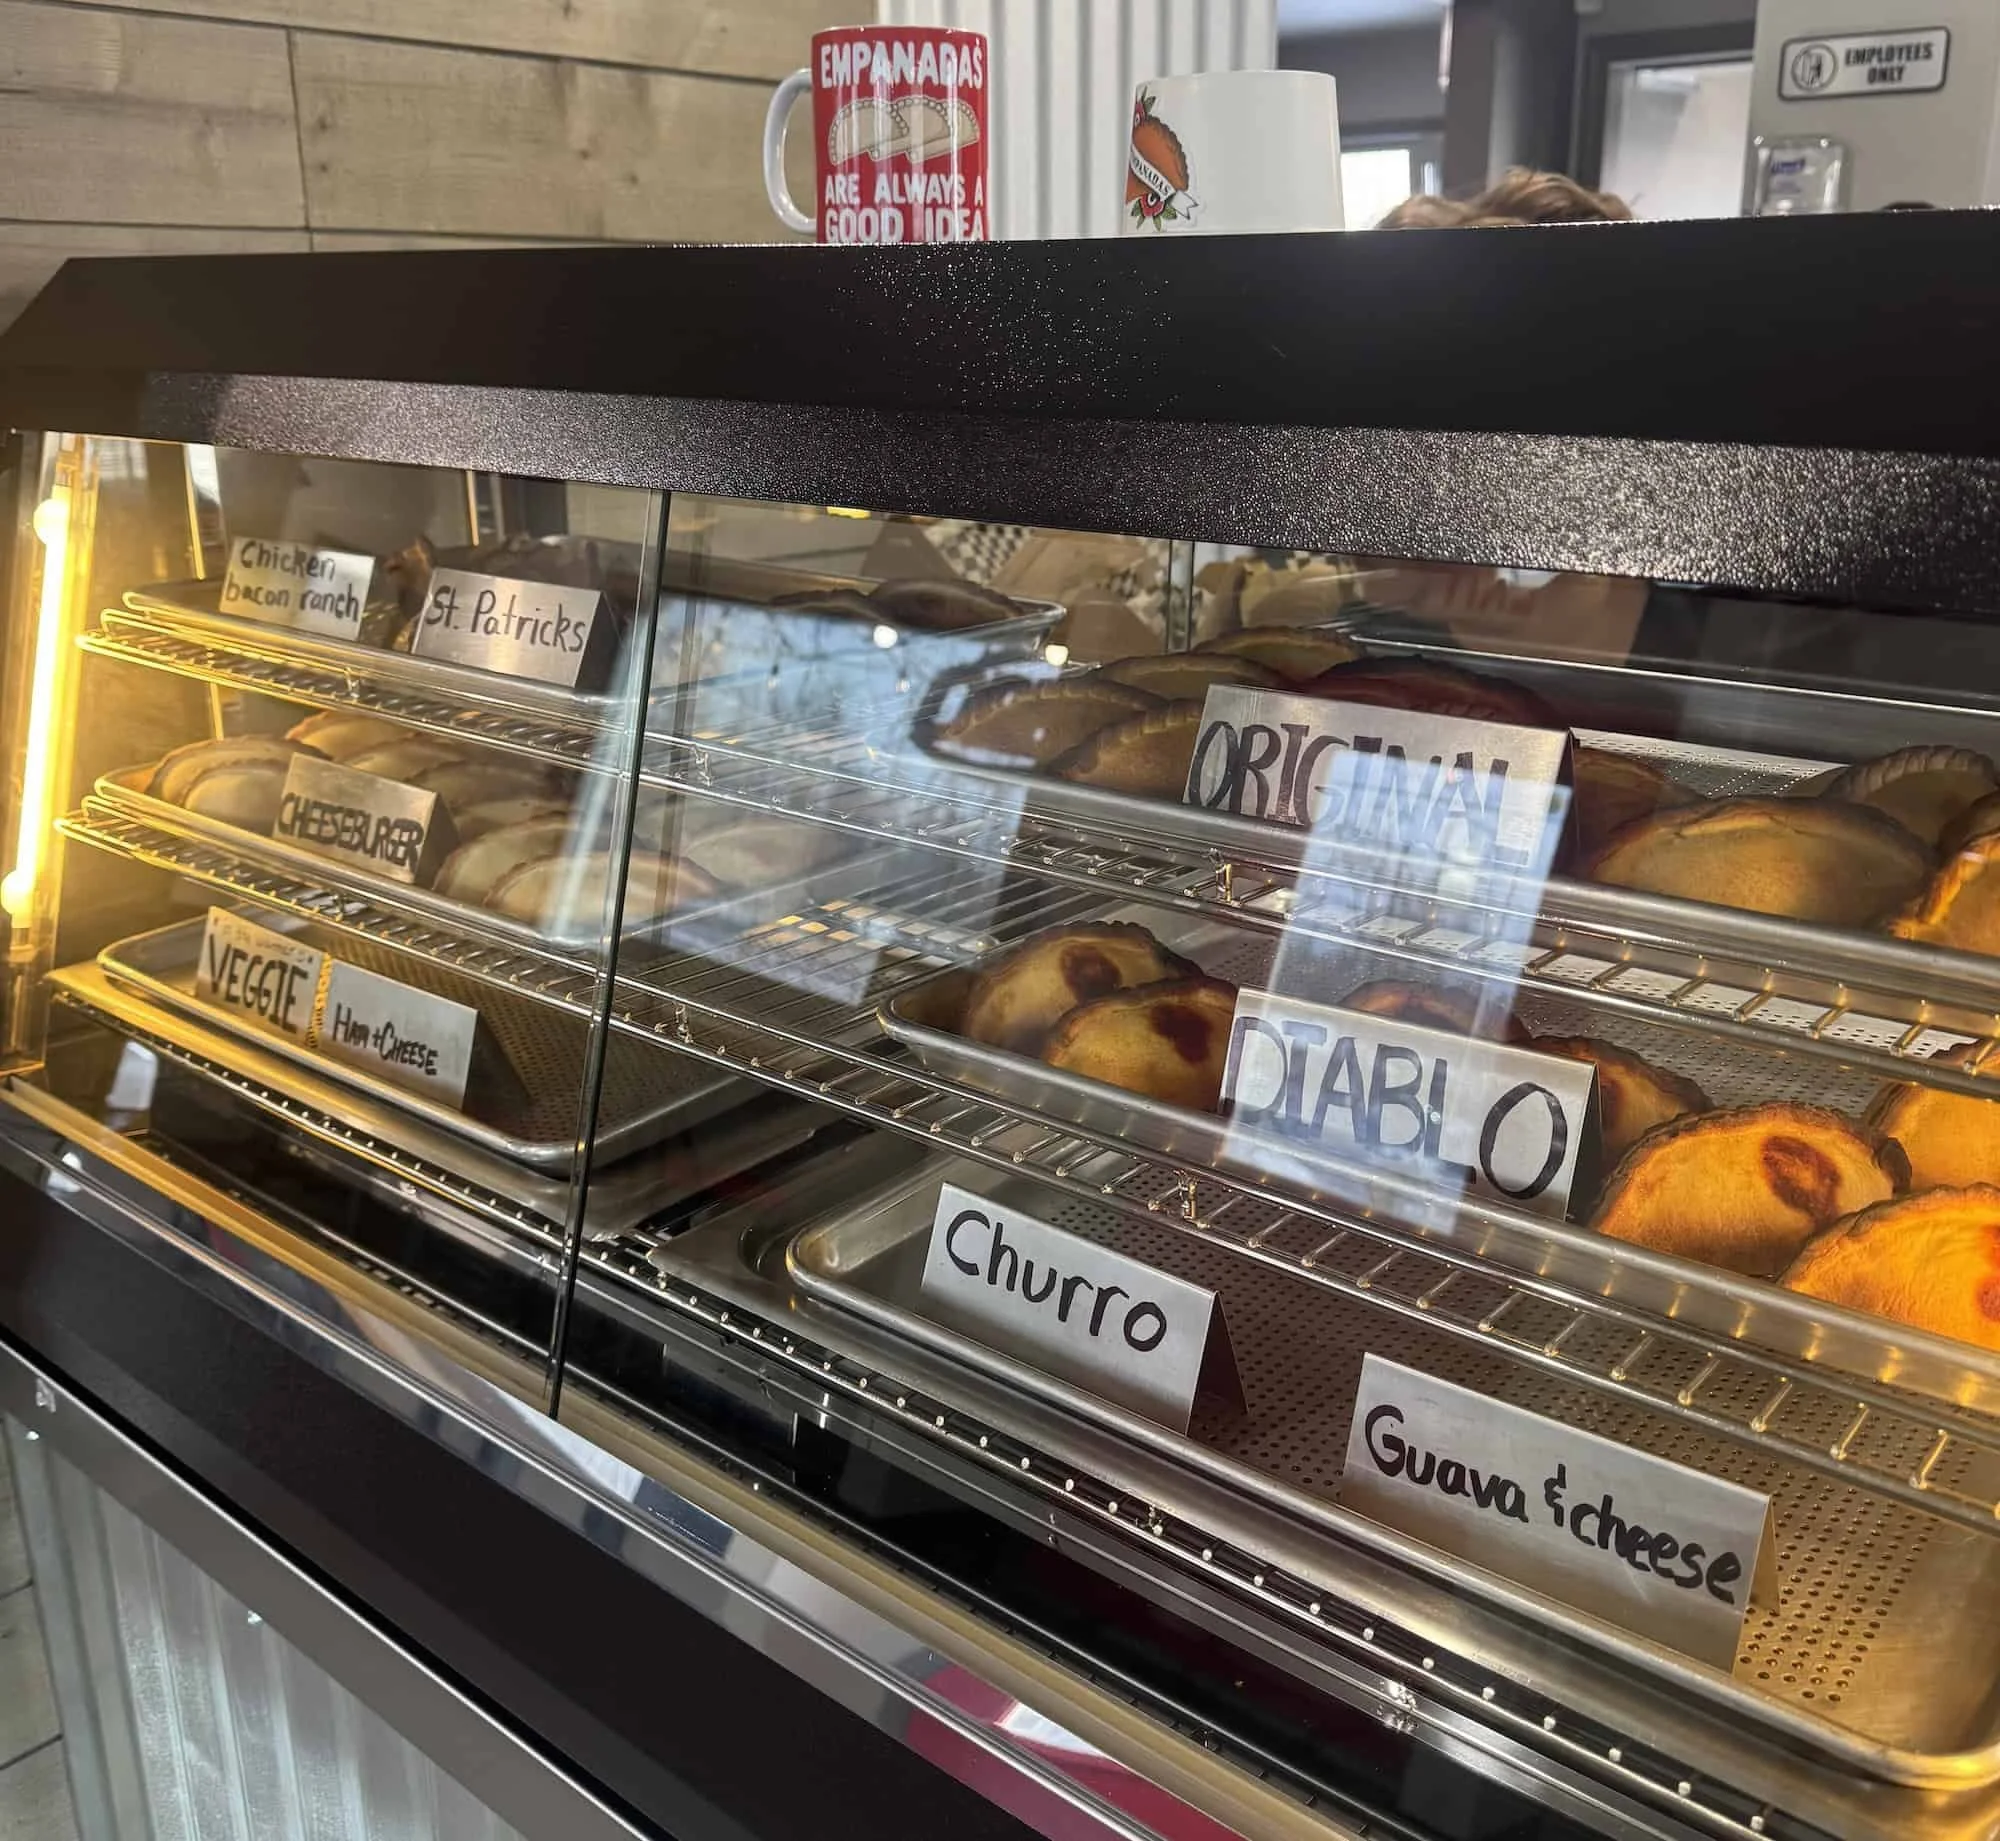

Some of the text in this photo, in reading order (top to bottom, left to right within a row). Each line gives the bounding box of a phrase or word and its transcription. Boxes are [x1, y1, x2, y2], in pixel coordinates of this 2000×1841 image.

[820, 39, 983, 89] EMPANADAS
[1845, 43, 1933, 65] EMPLOYEES
[1867, 66, 1905, 84] ONLY
[825, 173, 983, 206] ARE ALWAYS A
[825, 207, 985, 244] GOOD IDEA
[240, 540, 336, 581] Chicken
[224, 573, 360, 623] bacon ranch
[425, 585, 586, 653] St. Patricks
[1187, 719, 1530, 868] ORIGINAL
[276, 792, 425, 868] CHEESEBURGER
[208, 933, 309, 1034] VEGGIE
[1219, 1016, 1568, 1200] DIABLO
[944, 1209, 1168, 1352] Churro
[1364, 1404, 1528, 1525] Guava
